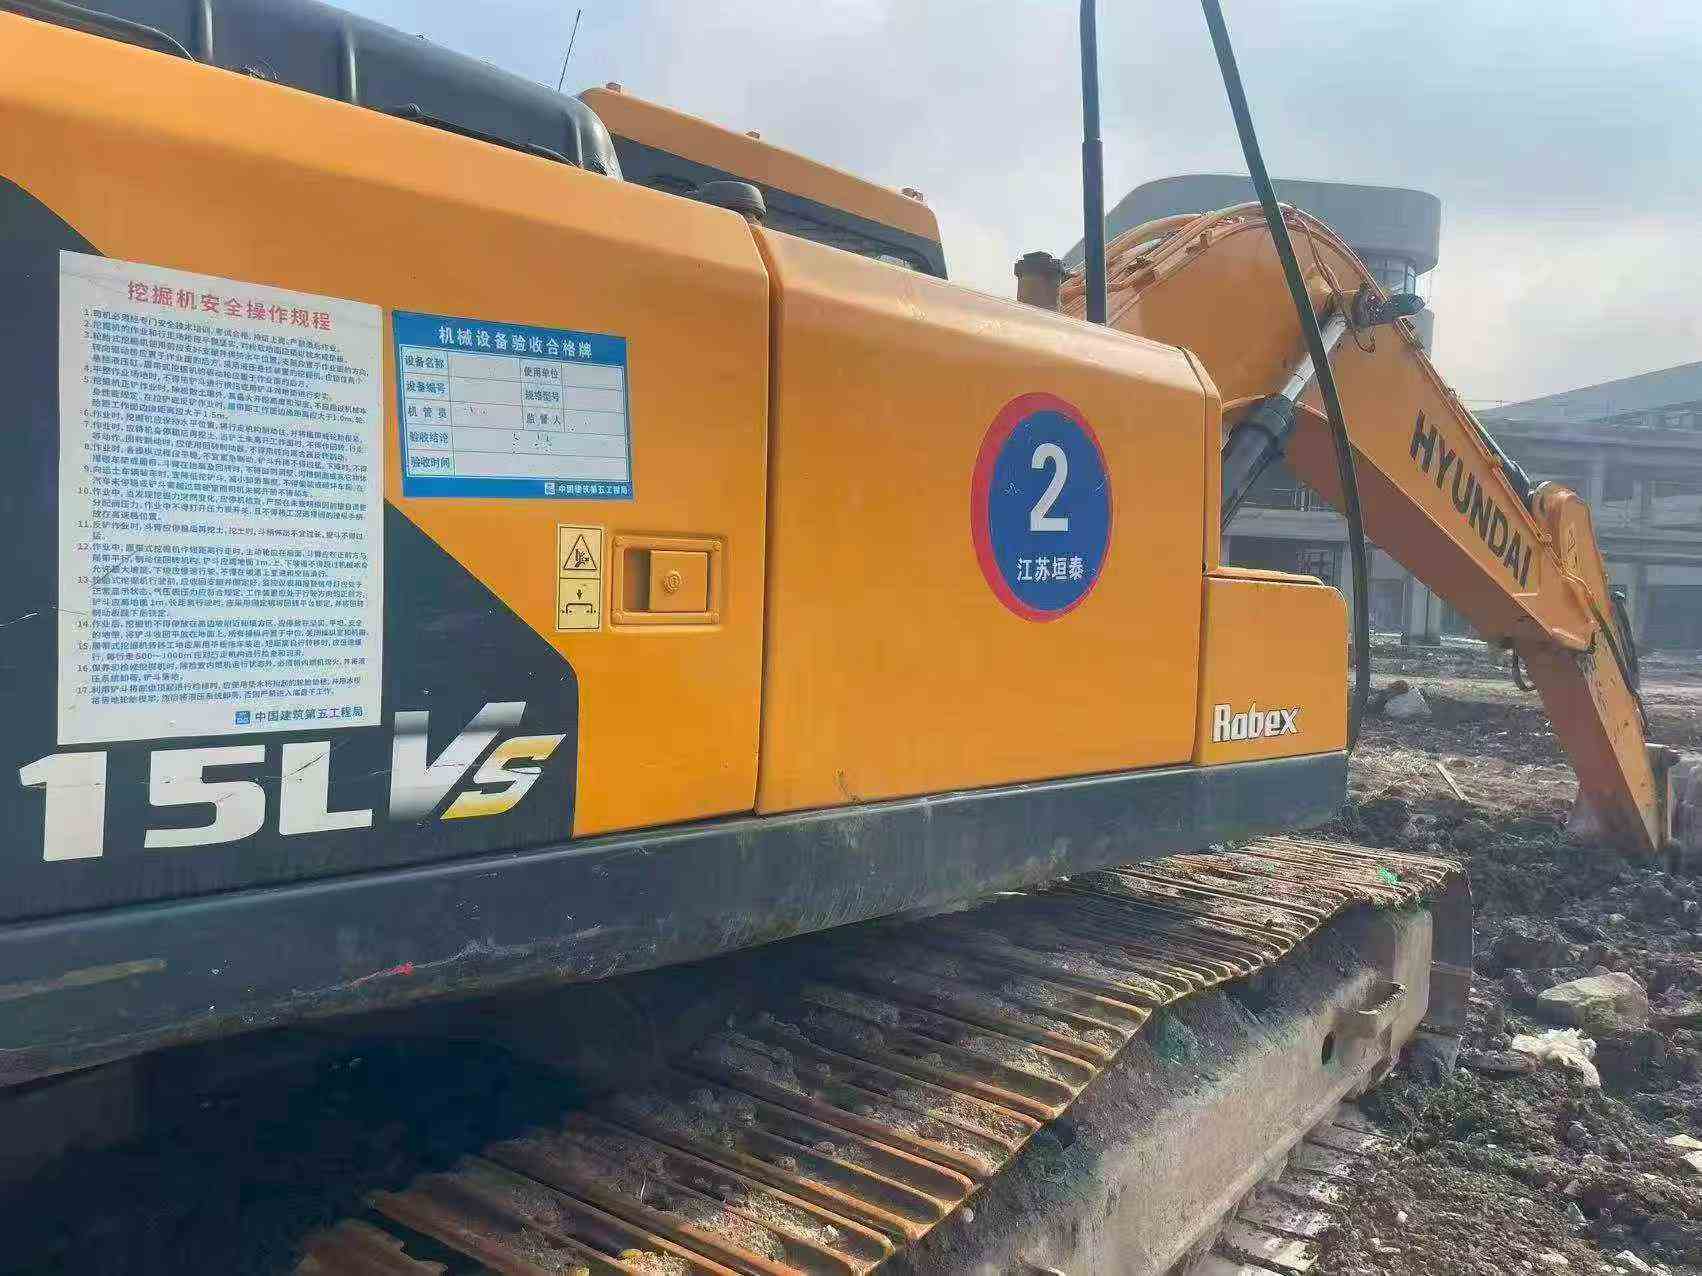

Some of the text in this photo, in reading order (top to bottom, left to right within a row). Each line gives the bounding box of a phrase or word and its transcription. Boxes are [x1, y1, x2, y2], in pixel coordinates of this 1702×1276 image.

[127, 279, 331, 332] 挖掘机安全操作规程
[438, 325, 592, 358] 机械设备验收合格牌
[404, 355, 445, 369] 设备名称
[524, 366, 559, 379] 使用单位
[1031, 443, 1068, 532] 2
[1409, 408, 1532, 588] HYUNDAI
[255, 706, 363, 722] 中国建筑第五工程局
[1213, 702, 1300, 743] Robex
